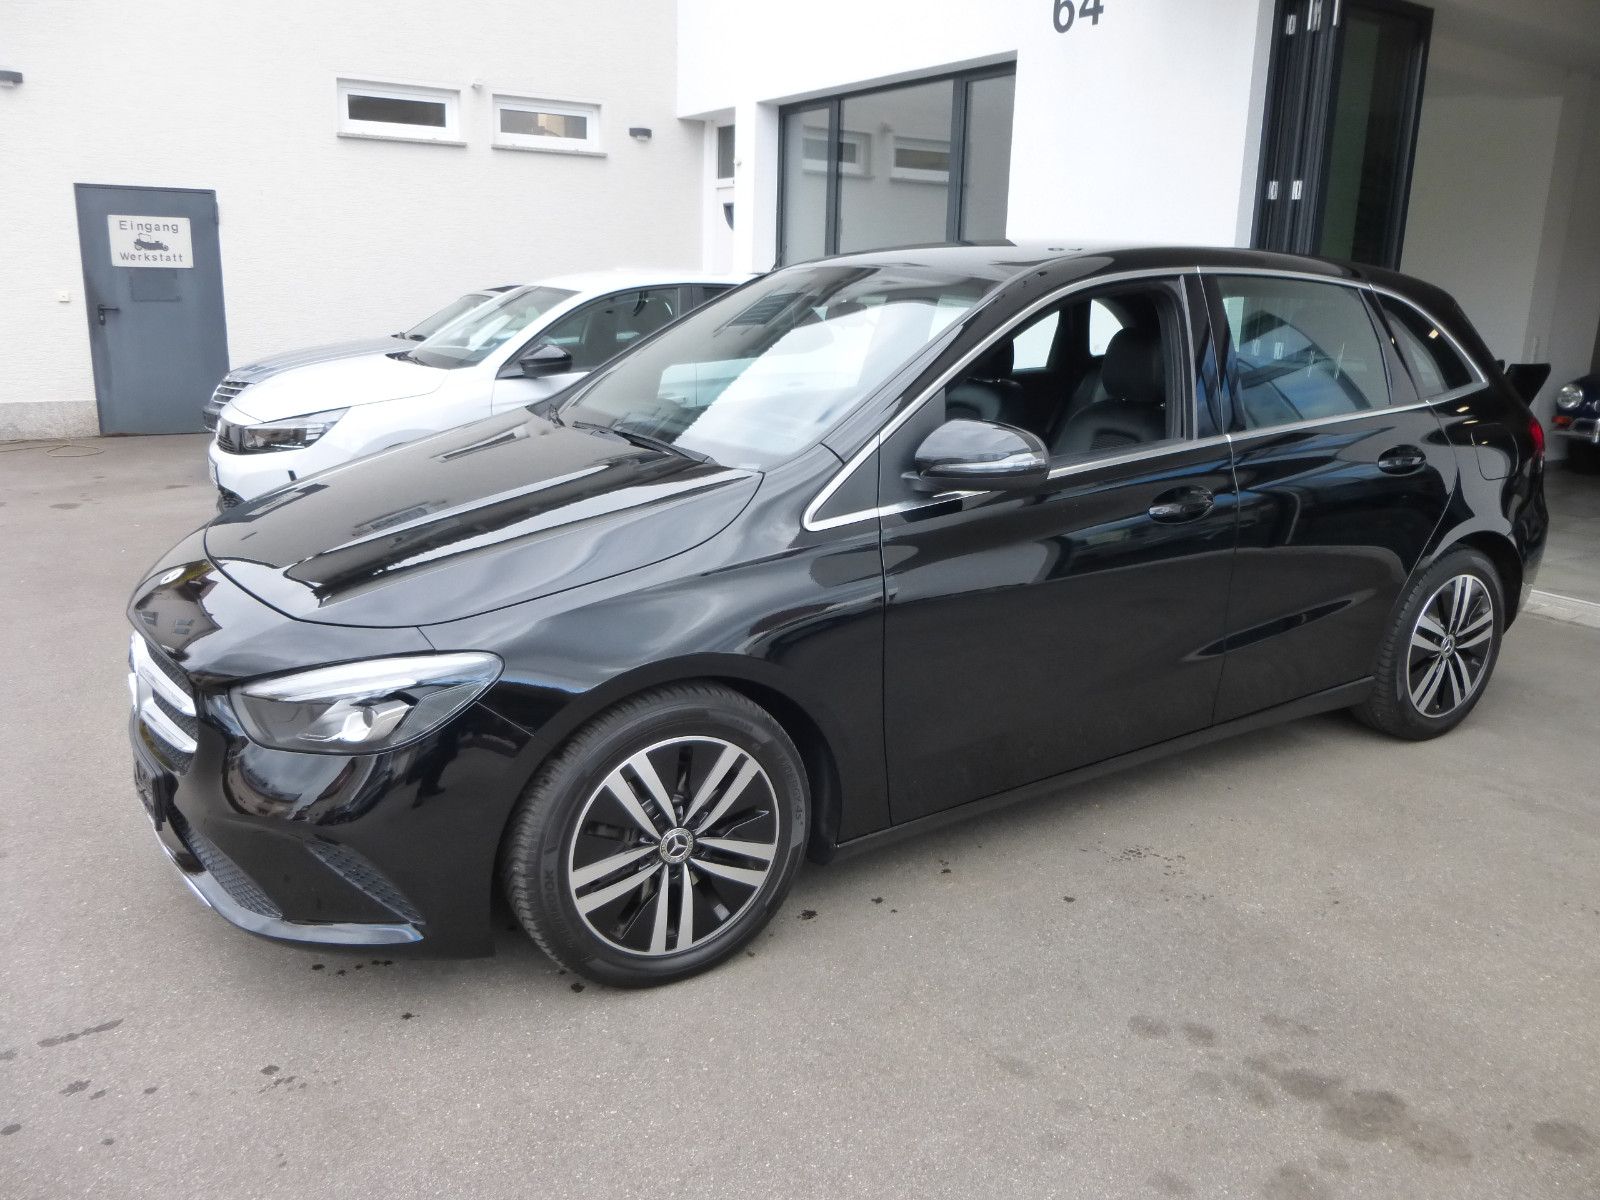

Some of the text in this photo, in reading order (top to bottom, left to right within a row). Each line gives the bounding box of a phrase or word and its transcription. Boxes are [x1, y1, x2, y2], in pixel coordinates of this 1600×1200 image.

[1053, 0, 1104, 33] 64
[119, 220, 179, 233] Eingang
[120, 252, 183, 263] Werkstatt
